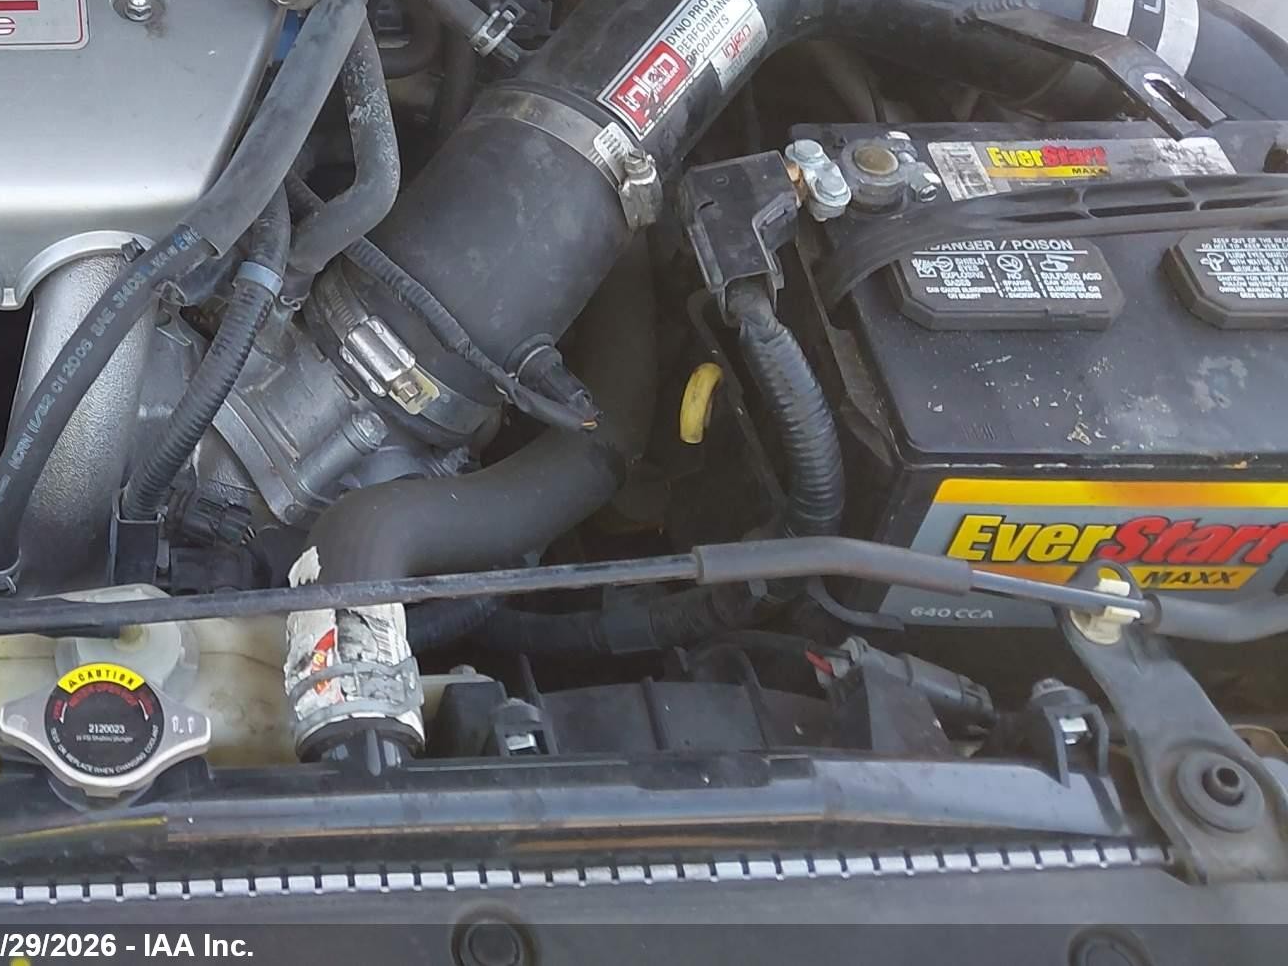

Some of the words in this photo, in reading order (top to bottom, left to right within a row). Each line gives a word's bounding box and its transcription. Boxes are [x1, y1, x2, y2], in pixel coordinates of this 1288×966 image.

[665, 18, 692, 46] DYNO
[685, 15, 730, 69] PRODUCTS
[986, 145, 1108, 169] EverStart
[1012, 239, 1074, 251] POISON
[1082, 272, 1102, 280] ACID
[945, 513, 1288, 565] EverStart
[1141, 571, 1240, 586] MAXX
[910, 605, 951, 620] 640
[954, 605, 995, 620] CCA
[78, 669, 135, 684] CAUTION
[88, 723, 126, 734] 2120023
